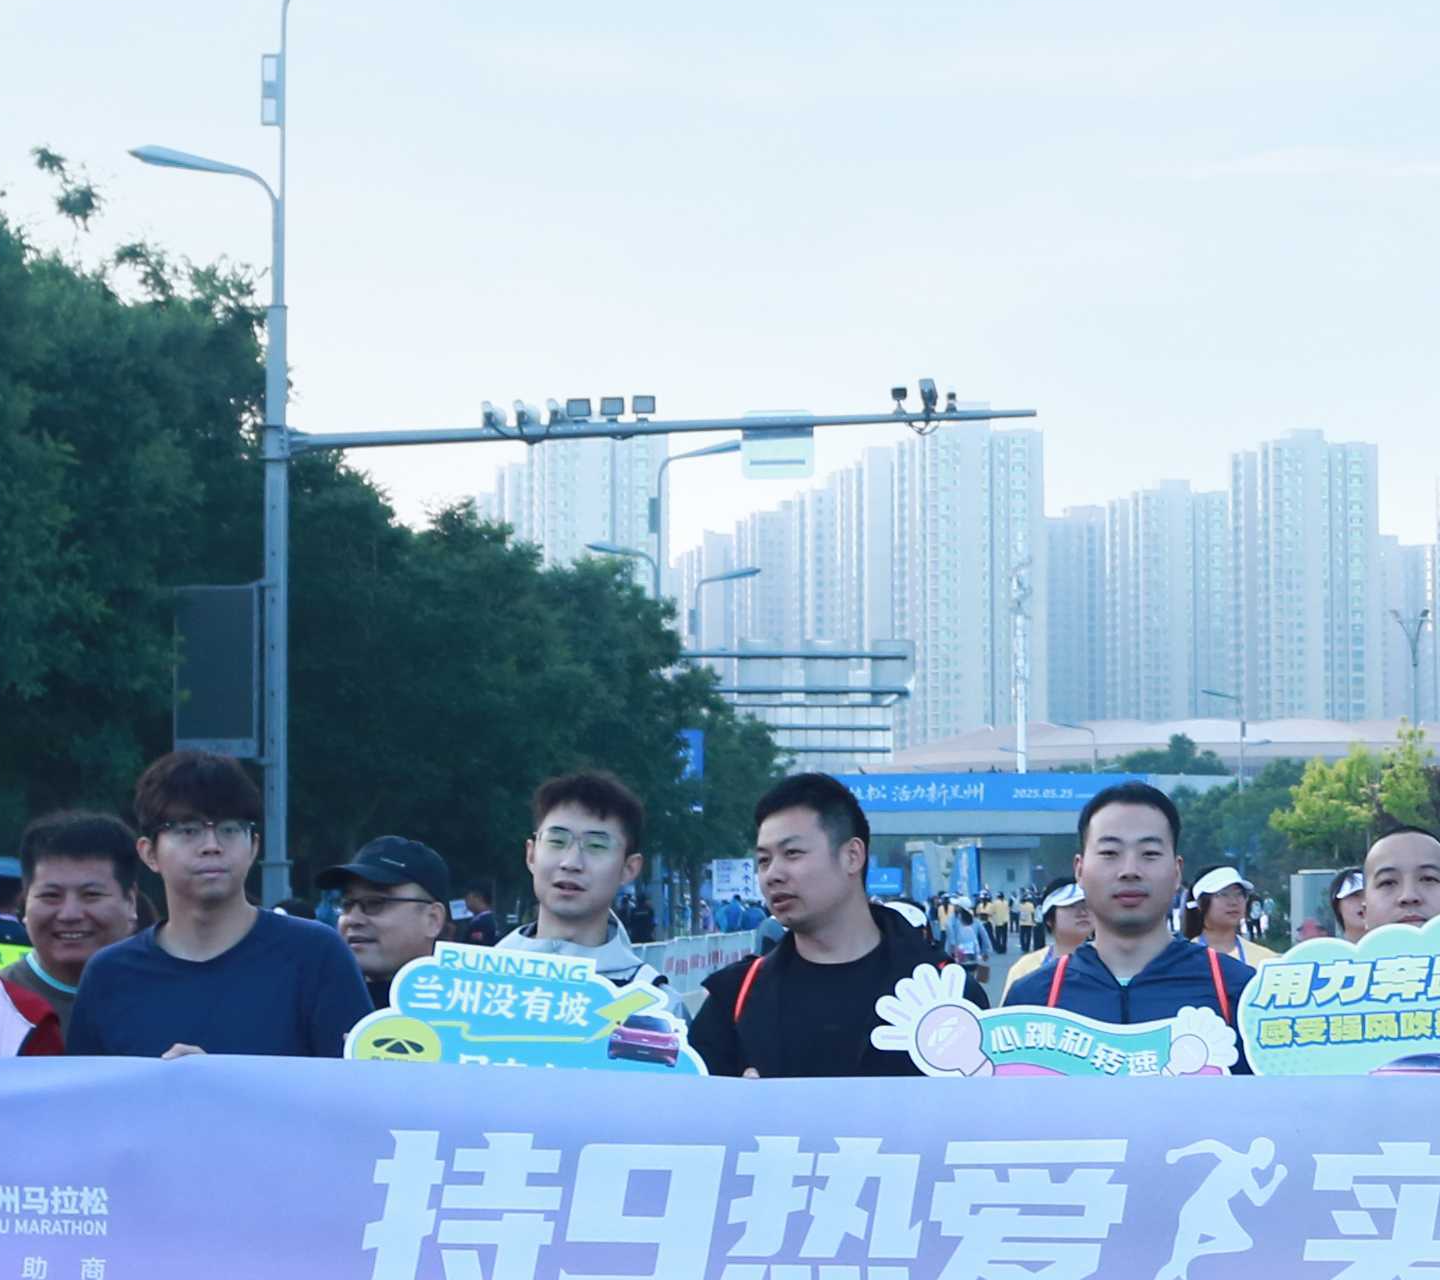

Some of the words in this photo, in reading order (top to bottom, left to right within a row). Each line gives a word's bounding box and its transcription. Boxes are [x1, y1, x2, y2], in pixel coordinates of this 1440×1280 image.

[439, 949, 589, 983] RUNNING
[412, 974, 595, 1028] 兰州没有坡
[991, 1021, 1162, 1077] 心跳和转速
[14, 1219, 108, 1237] MARATHON
